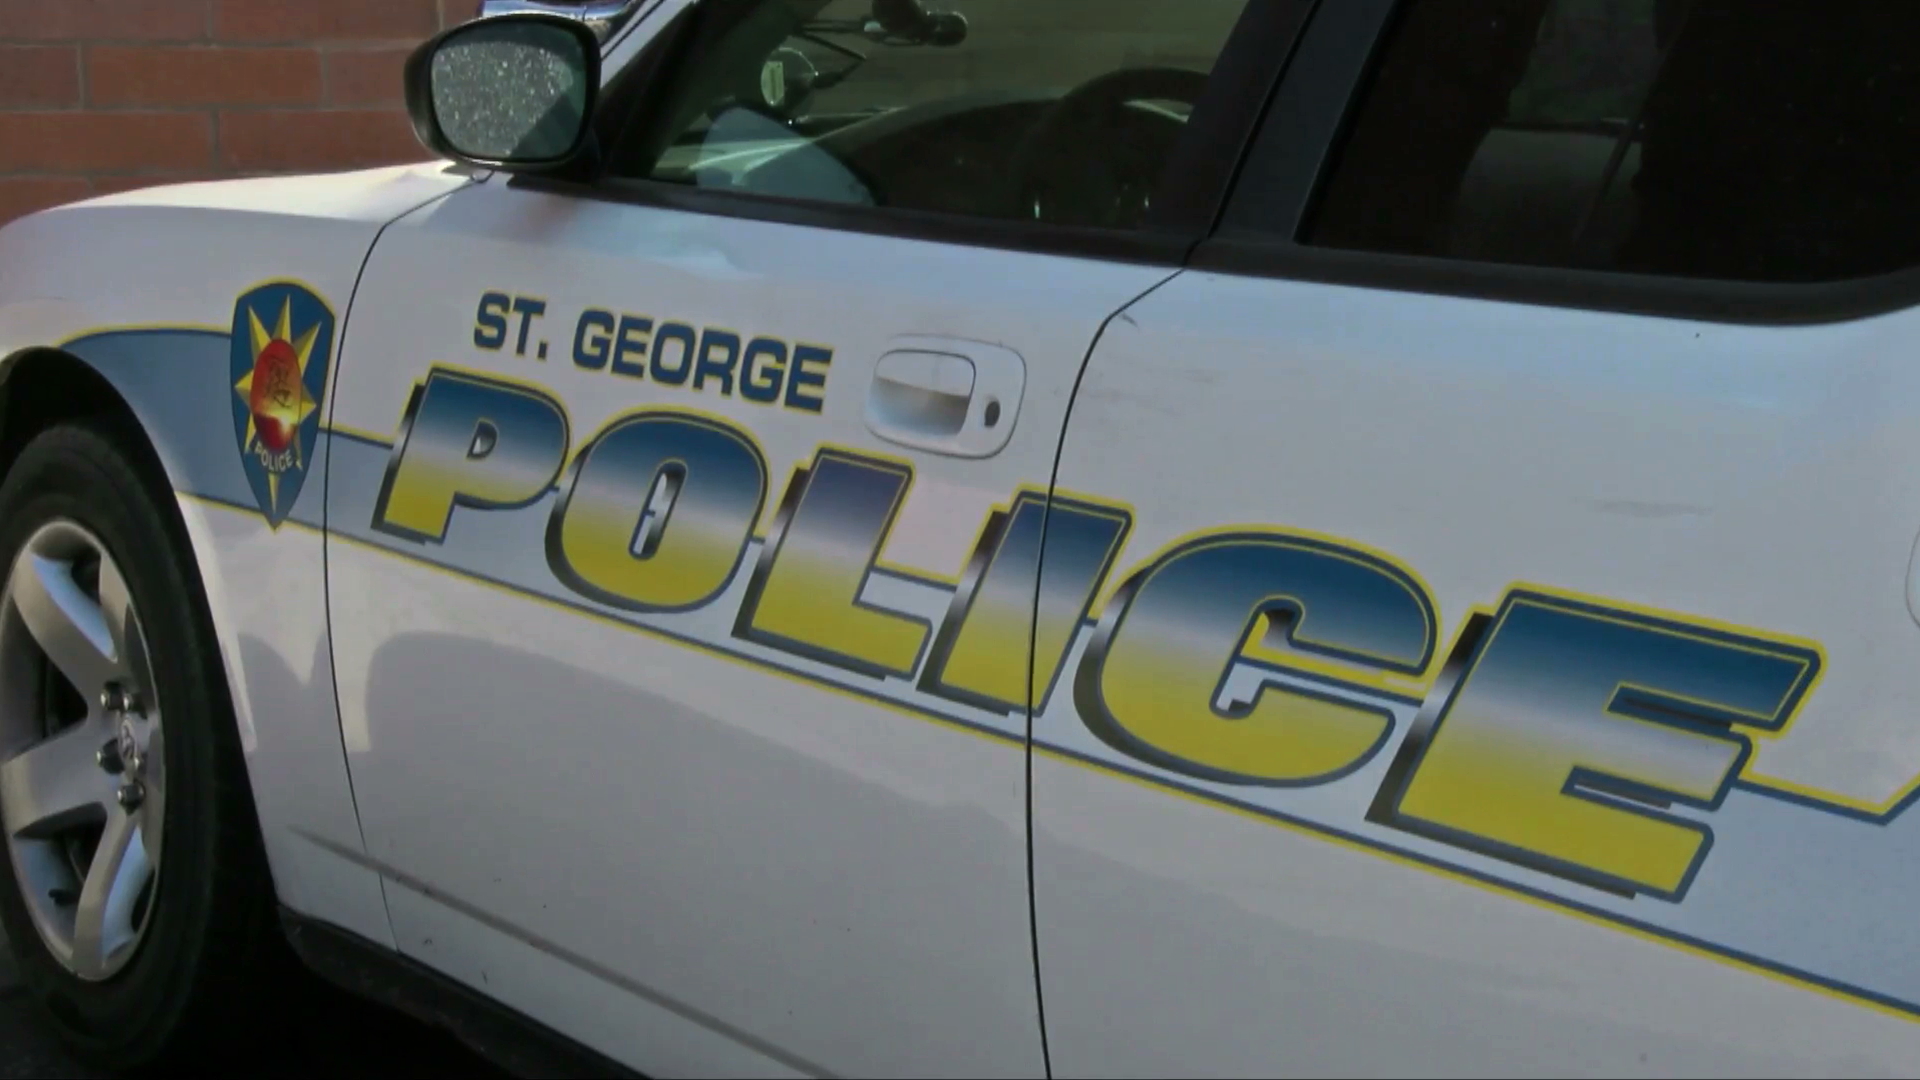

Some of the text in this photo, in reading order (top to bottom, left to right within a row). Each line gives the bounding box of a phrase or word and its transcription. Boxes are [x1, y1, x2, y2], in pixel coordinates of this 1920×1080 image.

[473, 290, 835, 415] ST. GEORGE
[255, 440, 293, 472] POLICE
[371, 363, 1825, 904] POLICE
